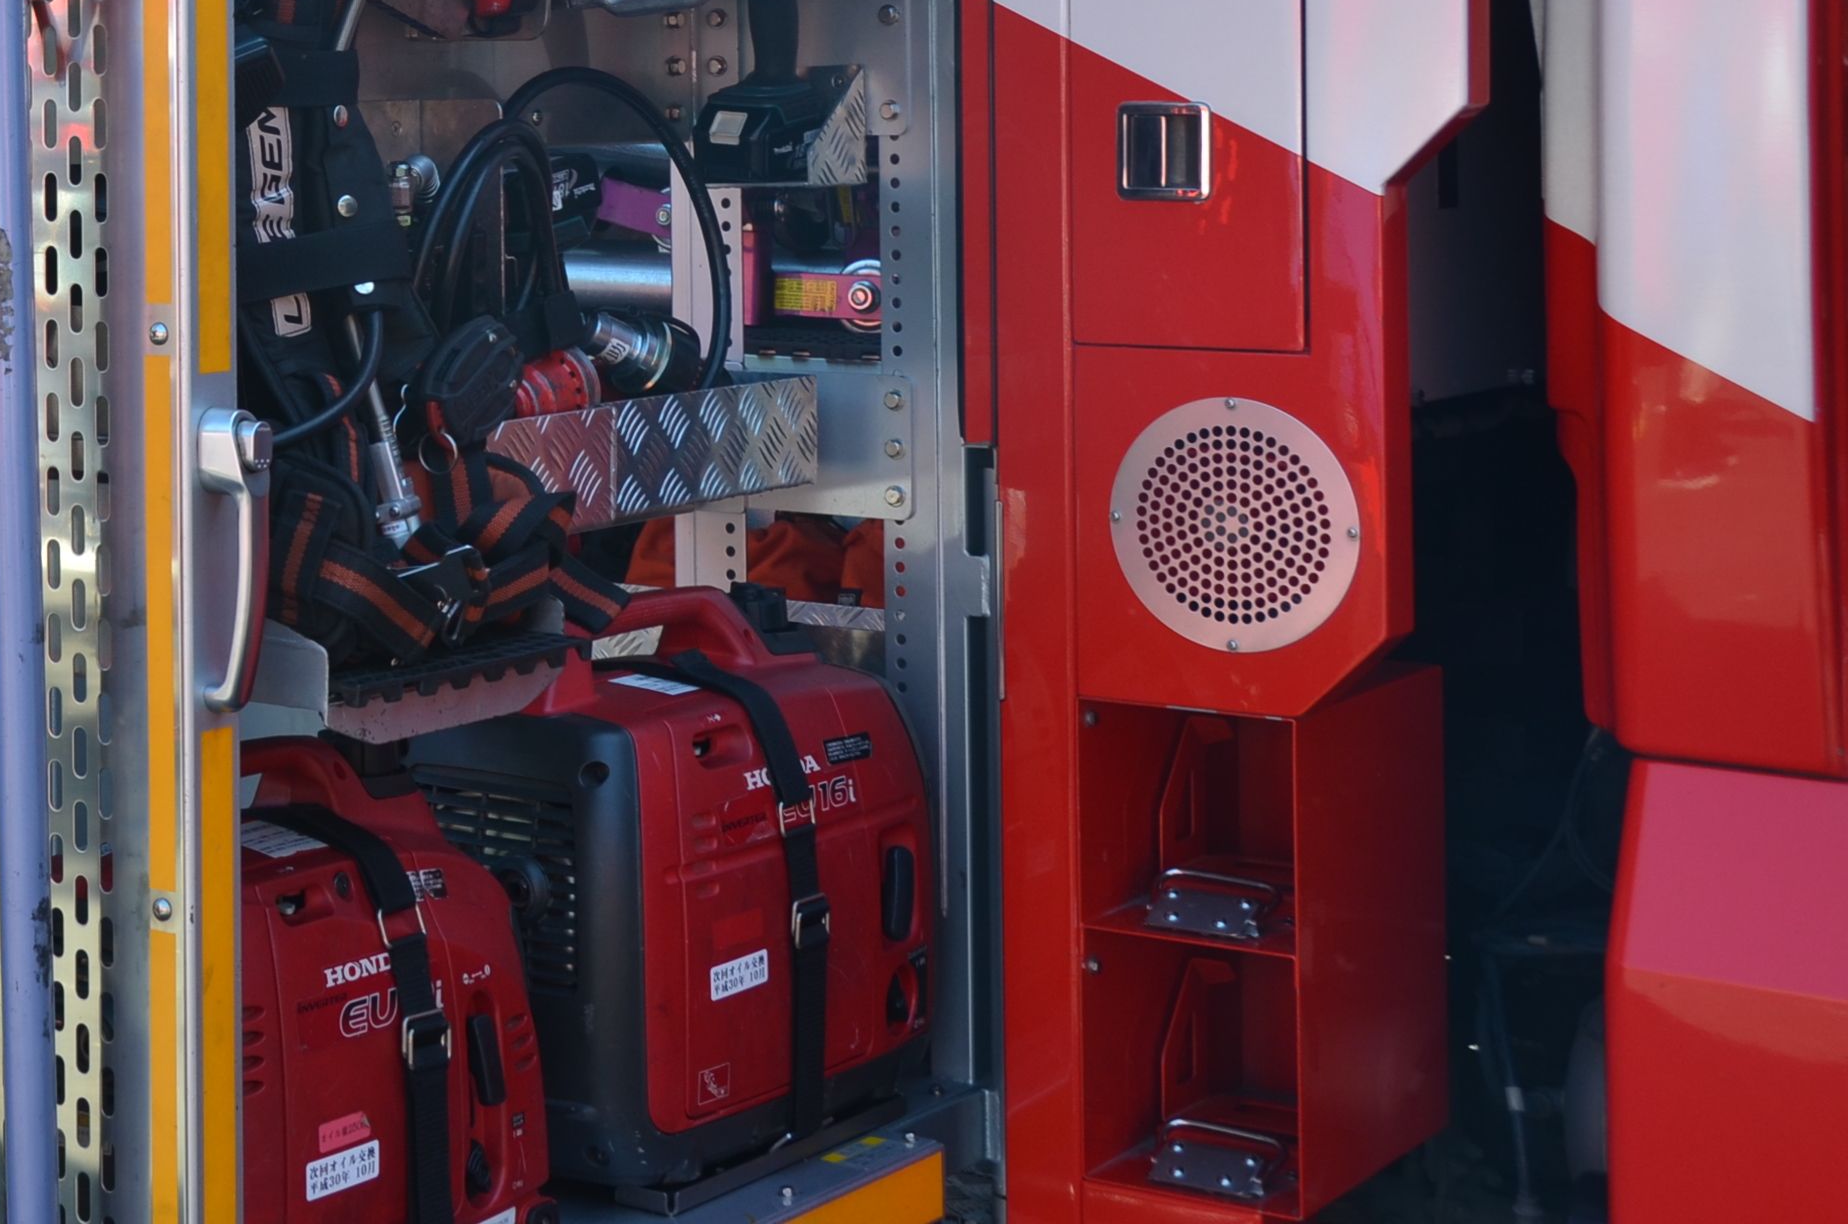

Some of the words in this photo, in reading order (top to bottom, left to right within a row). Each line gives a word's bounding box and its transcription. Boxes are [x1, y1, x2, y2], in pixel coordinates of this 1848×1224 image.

[323, 952, 392, 989] HOND
[309, 1146, 376, 1181] 次回オイル交換
